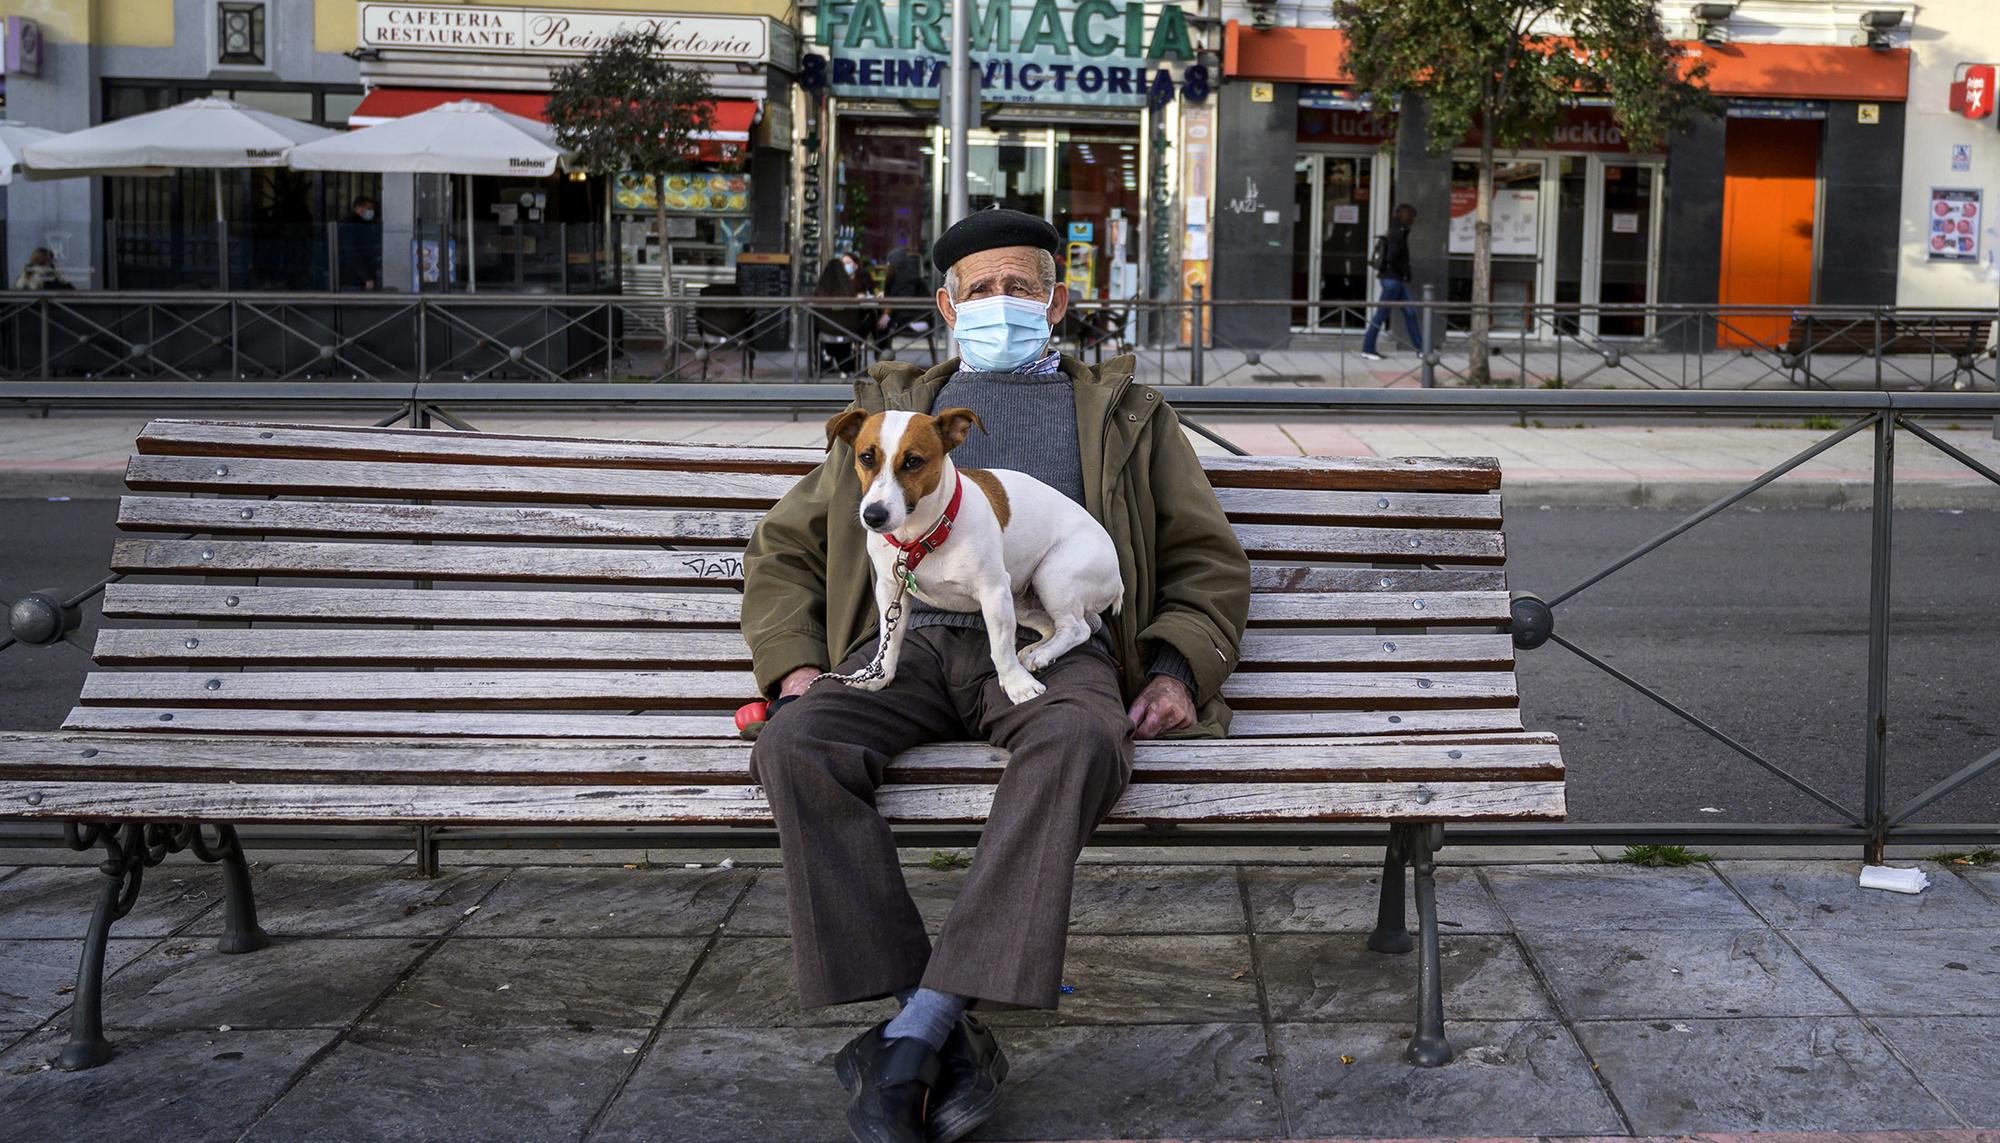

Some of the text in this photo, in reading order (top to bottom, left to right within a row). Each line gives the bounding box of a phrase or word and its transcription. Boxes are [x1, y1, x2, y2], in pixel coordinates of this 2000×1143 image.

[388, 10, 502, 27] CAFETERIA
[377, 27, 515, 46] RESTAURANTE
[815, 0, 1196, 60] FARMACIA
